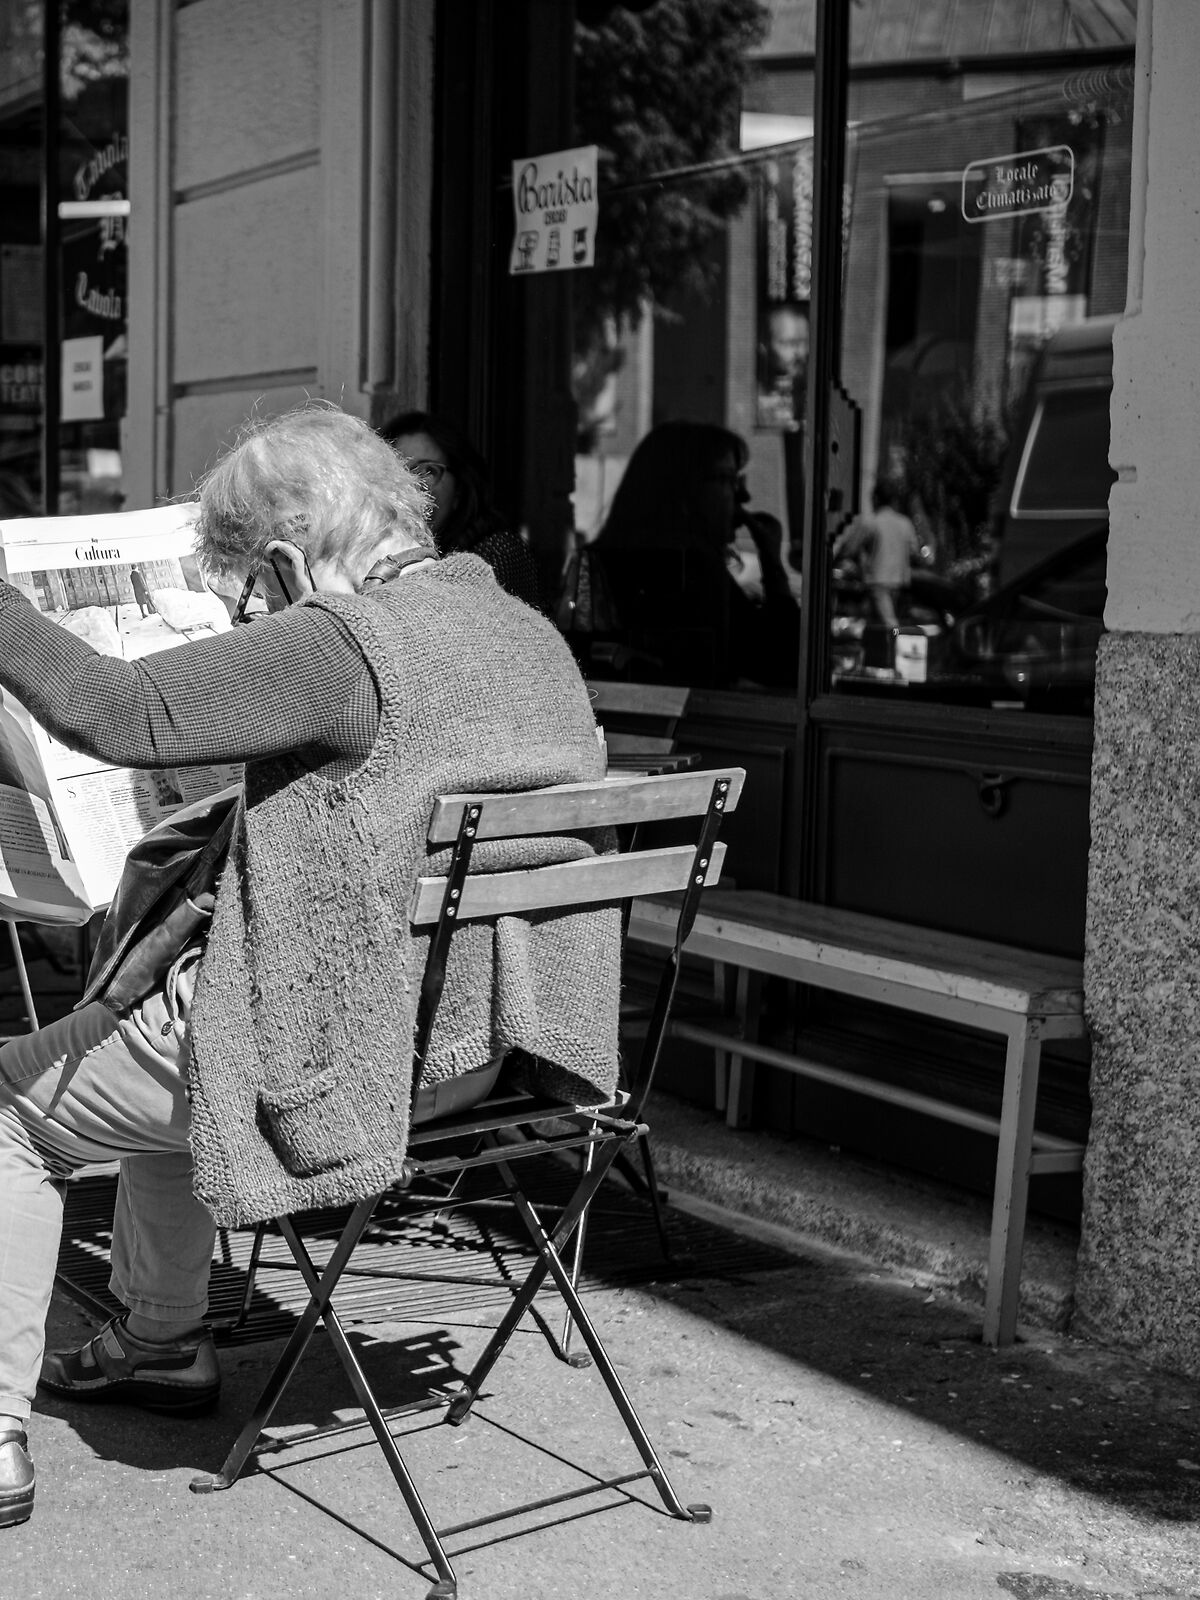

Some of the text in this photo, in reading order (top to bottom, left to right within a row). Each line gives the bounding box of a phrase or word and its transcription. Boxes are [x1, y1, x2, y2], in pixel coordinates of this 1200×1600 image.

[995, 162, 1038, 184] Locale
[518, 162, 592, 214] Barista
[976, 184, 1057, 210] Climatizzato
[75, 545, 120, 561] Cultura
